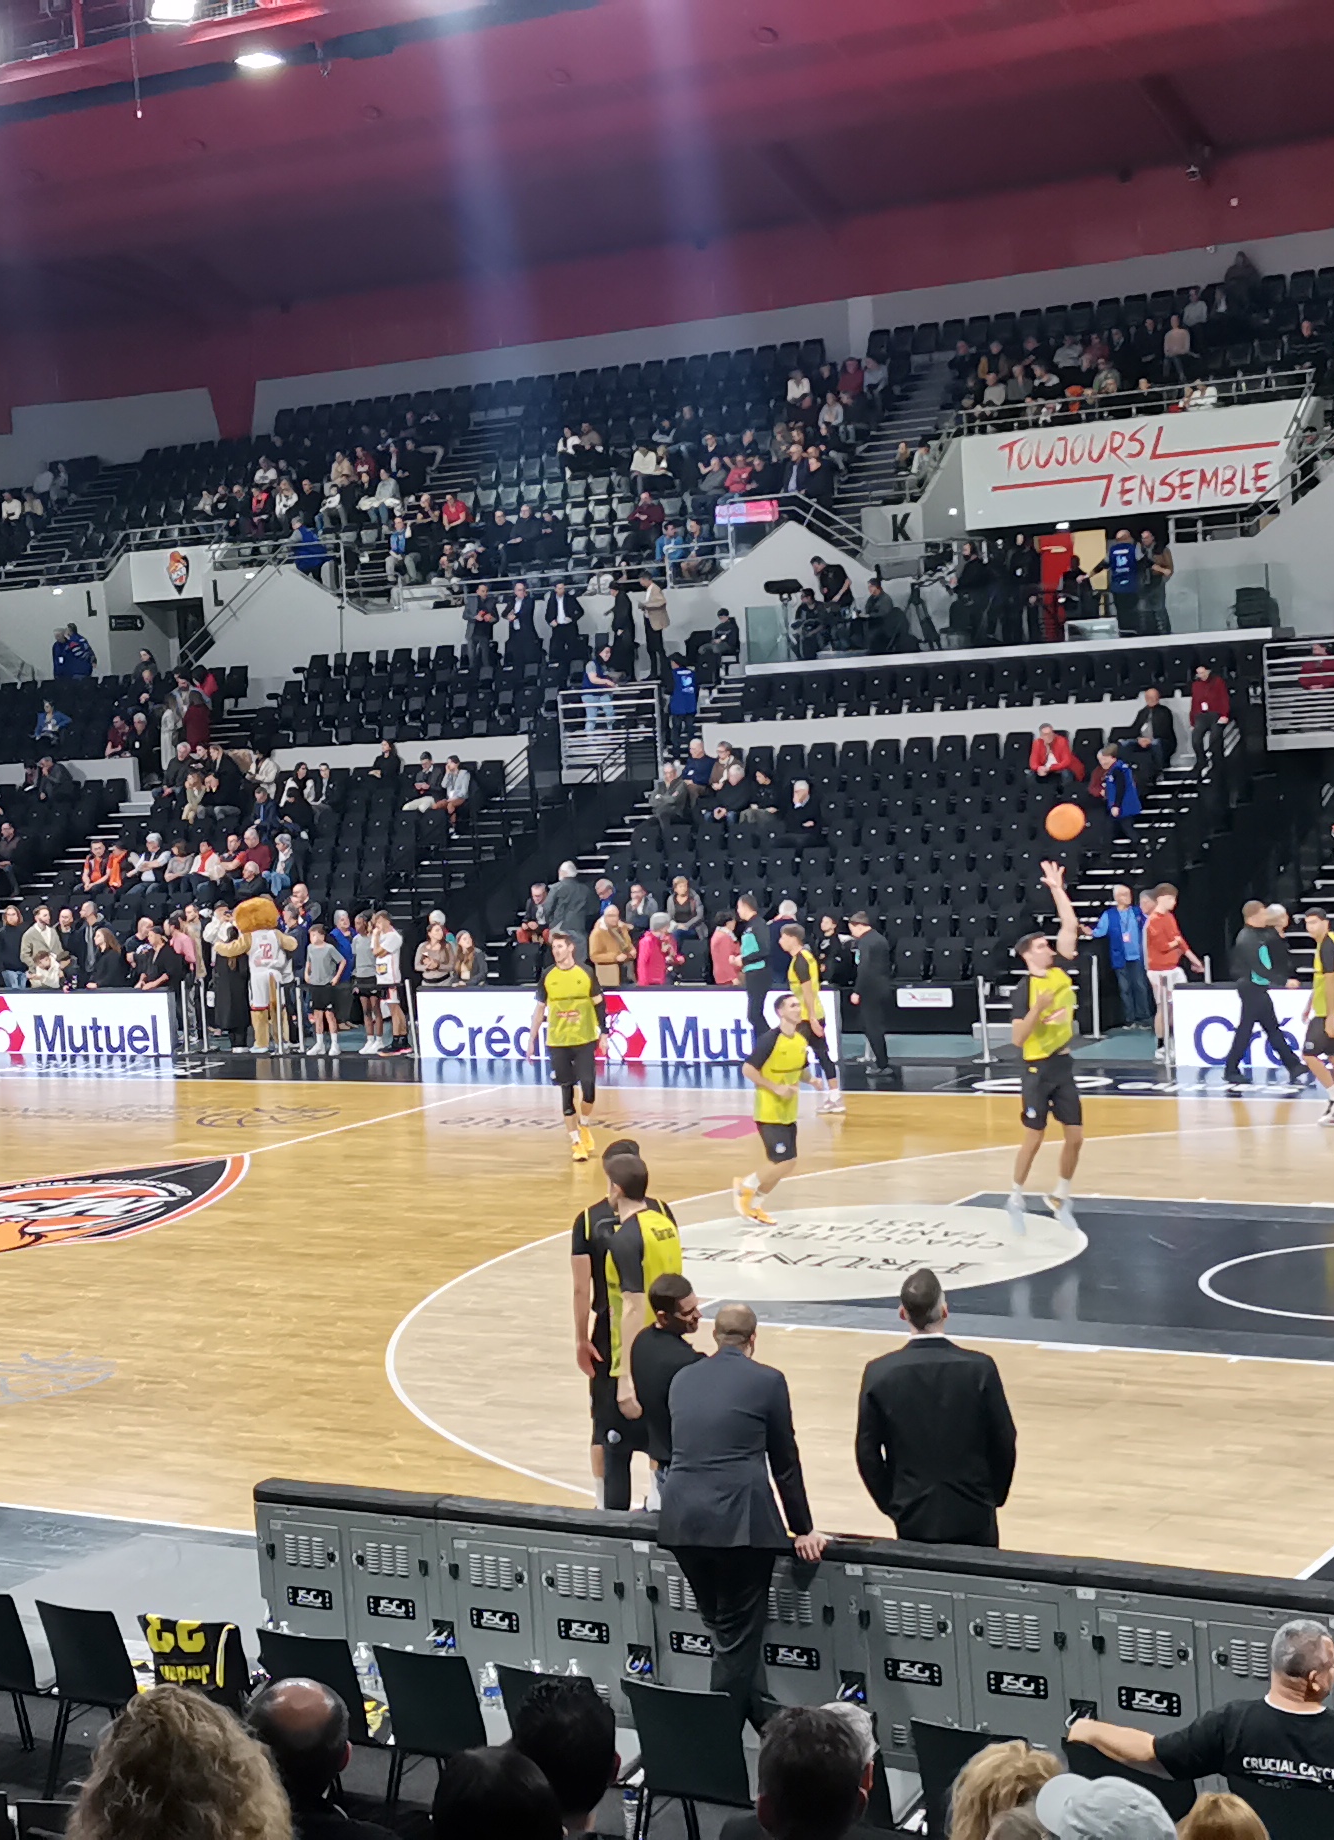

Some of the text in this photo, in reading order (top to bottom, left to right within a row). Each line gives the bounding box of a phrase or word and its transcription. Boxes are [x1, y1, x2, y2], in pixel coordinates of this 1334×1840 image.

[997, 424, 1147, 474] TOUJOURS
[1117, 460, 1274, 507] ENSEMBLE
[891, 511, 912, 542] K
[85, 589, 98, 617] L
[211, 578, 225, 607] L
[33, 1014, 160, 1054] Mutuel
[731, 1228, 1005, 1250] CHARCUTERIE
[146, 1613, 207, 1653] 23
[158, 1664, 210, 1686] Jordan
[1242, 1756, 1298, 1775] CRUCIAL
